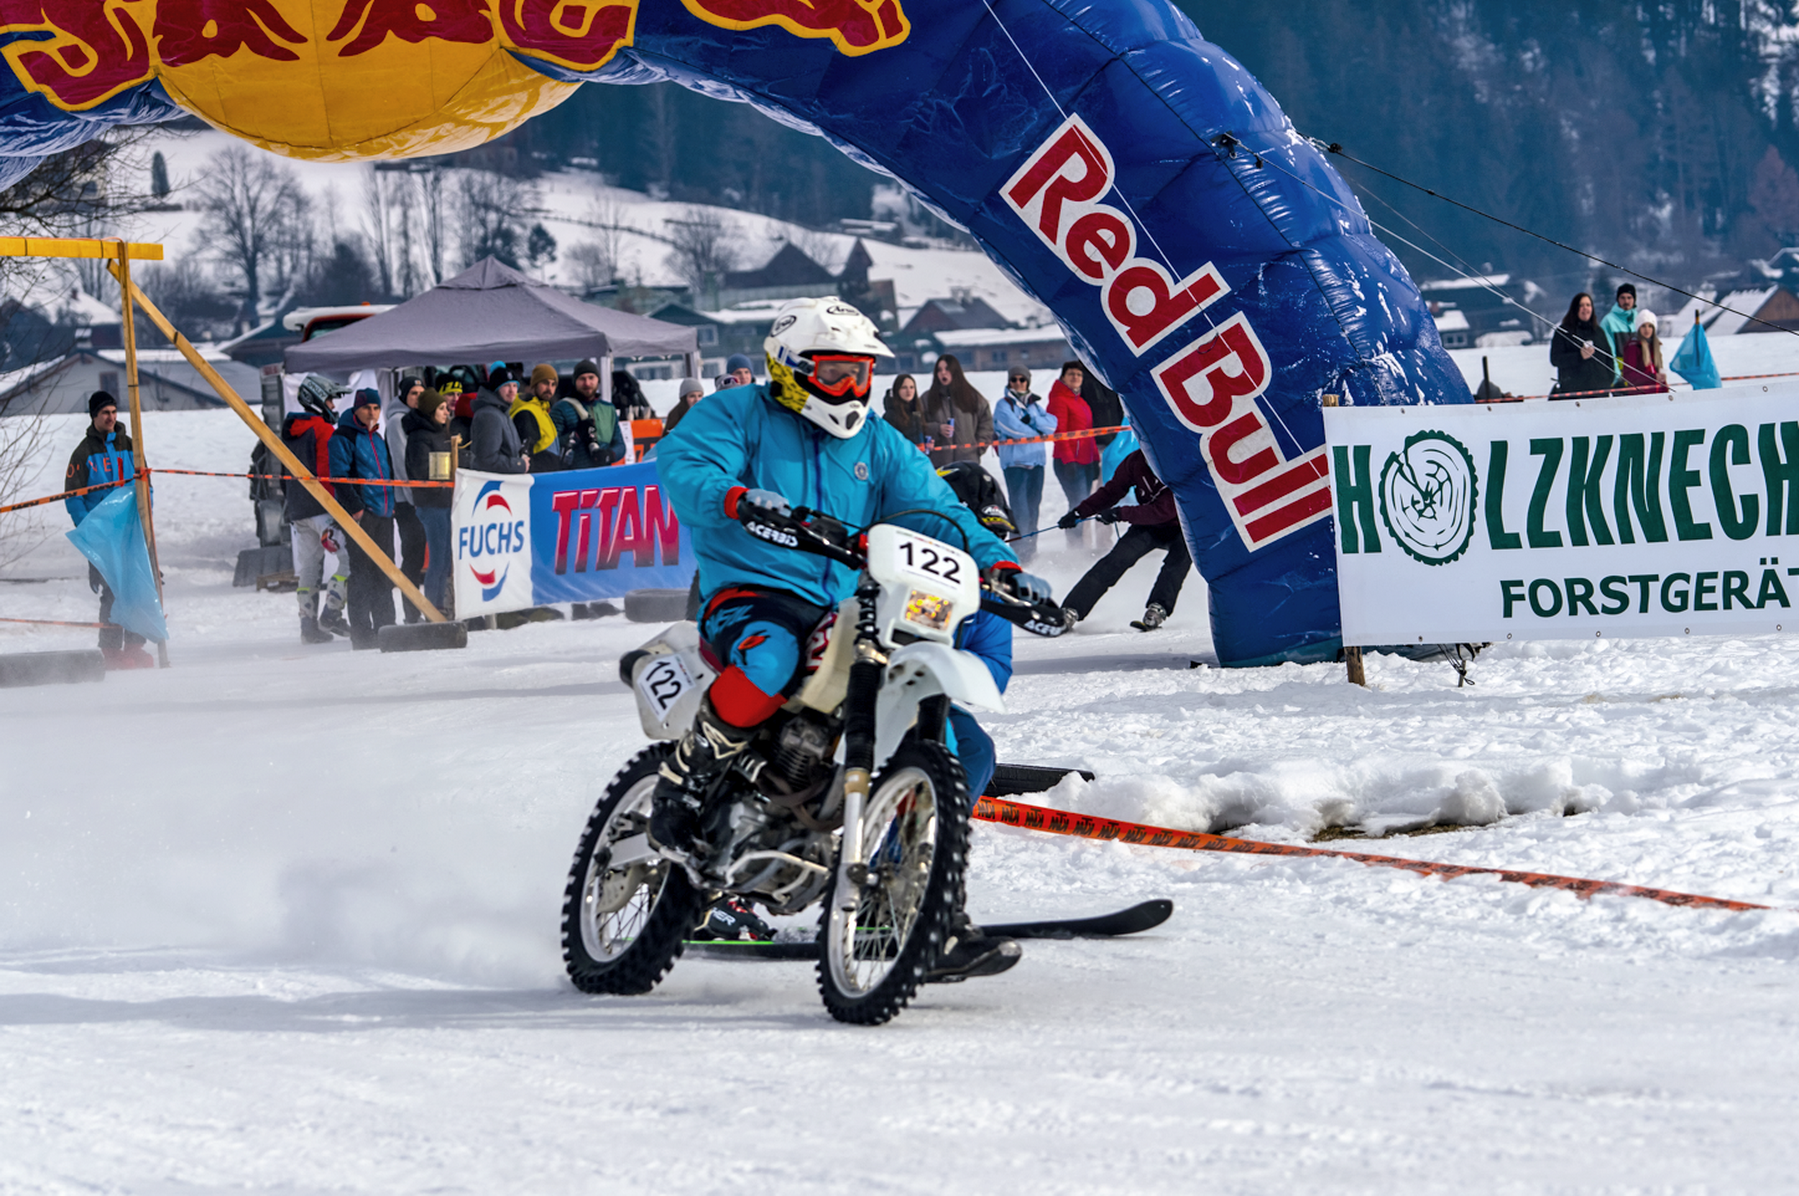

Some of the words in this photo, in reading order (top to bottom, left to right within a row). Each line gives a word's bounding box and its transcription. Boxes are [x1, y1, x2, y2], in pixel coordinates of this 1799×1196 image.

[1006, 122, 1223, 349] Red
[1158, 320, 1333, 545] Bull
[458, 520, 525, 560] FUCHS
[899, 541, 961, 585] 122
[646, 661, 682, 710] 122
